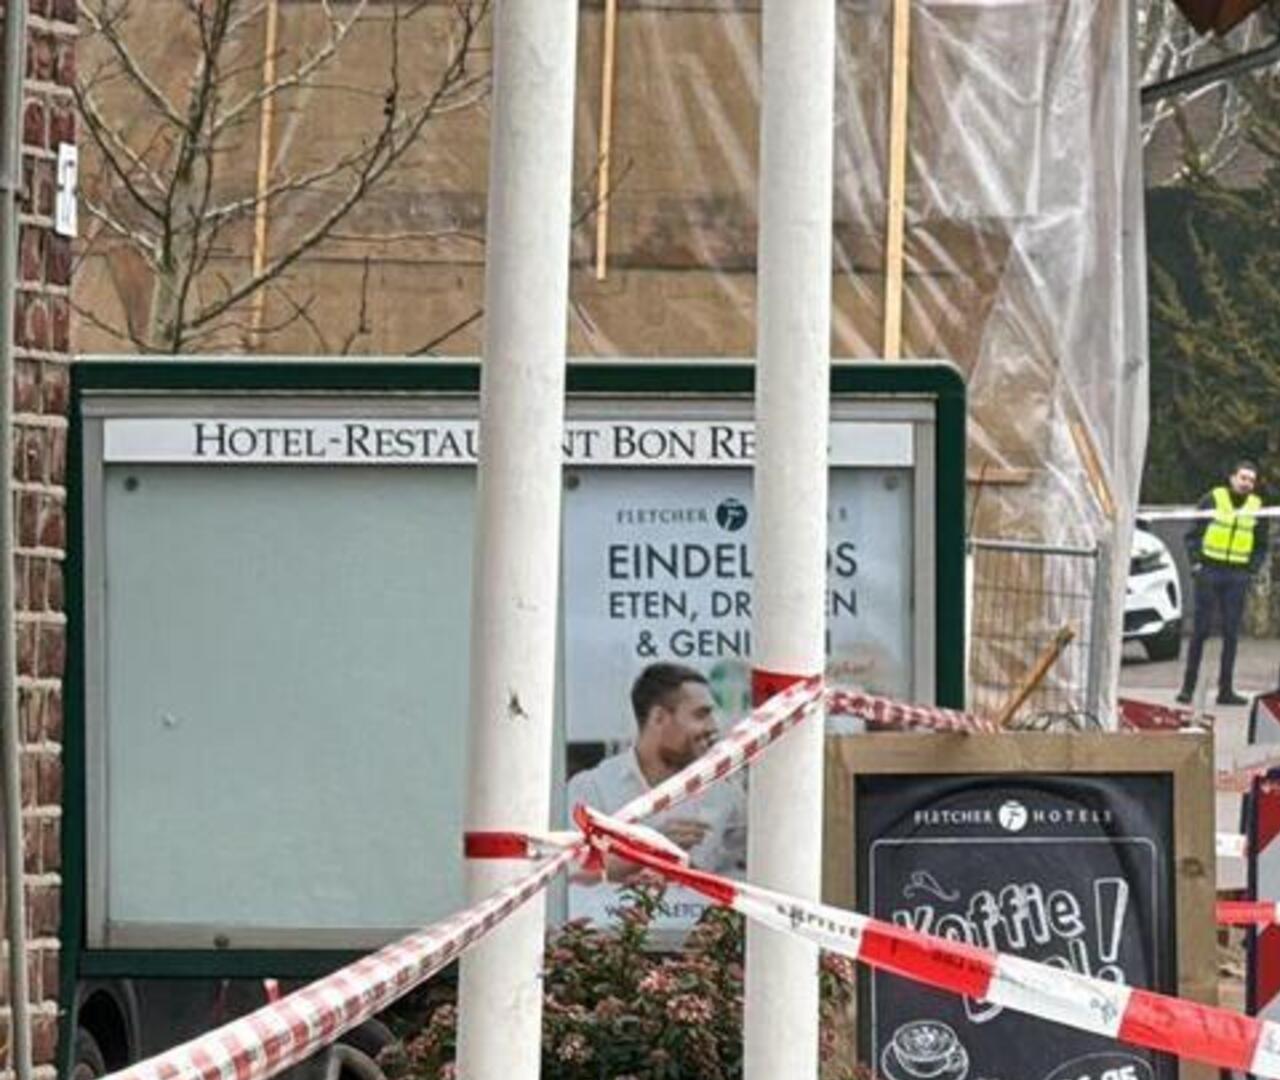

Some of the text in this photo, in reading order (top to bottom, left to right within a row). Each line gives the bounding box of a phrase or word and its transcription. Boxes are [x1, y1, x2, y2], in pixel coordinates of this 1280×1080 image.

[194, 423, 600, 459] HOTEL-RESTAT
[612, 426, 697, 459] BON
[616, 508, 709, 525] FLETCHER
[607, 542, 859, 580] EINDELS
[608, 590, 859, 623] ETEN, DREN
[635, 630, 657, 658] &
[913, 810, 1112, 825] FLETCHER HOTELS
